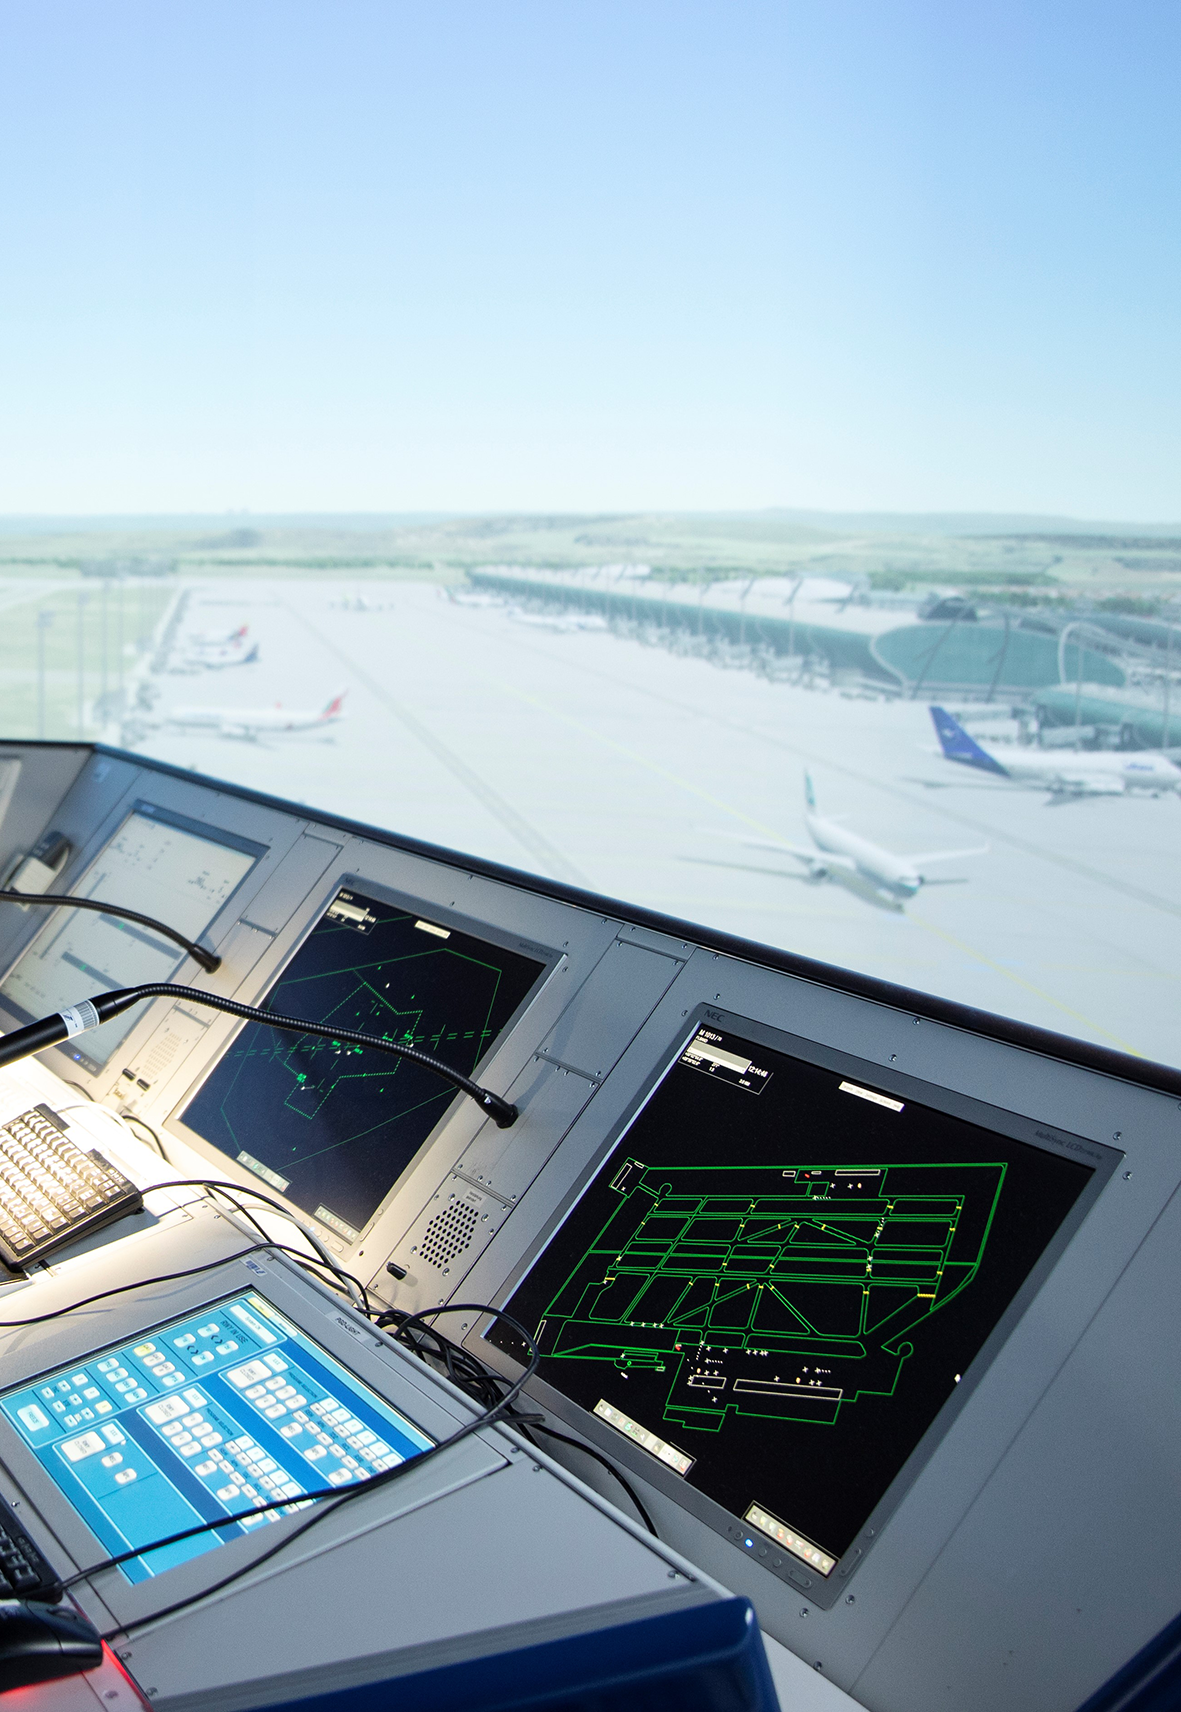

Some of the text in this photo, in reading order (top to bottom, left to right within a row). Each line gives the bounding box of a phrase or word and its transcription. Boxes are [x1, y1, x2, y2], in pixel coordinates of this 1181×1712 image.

[705, 1010, 725, 1022] NEC
[220, 1320, 233, 1329] RWY
[235, 1333, 248, 1343] USE
